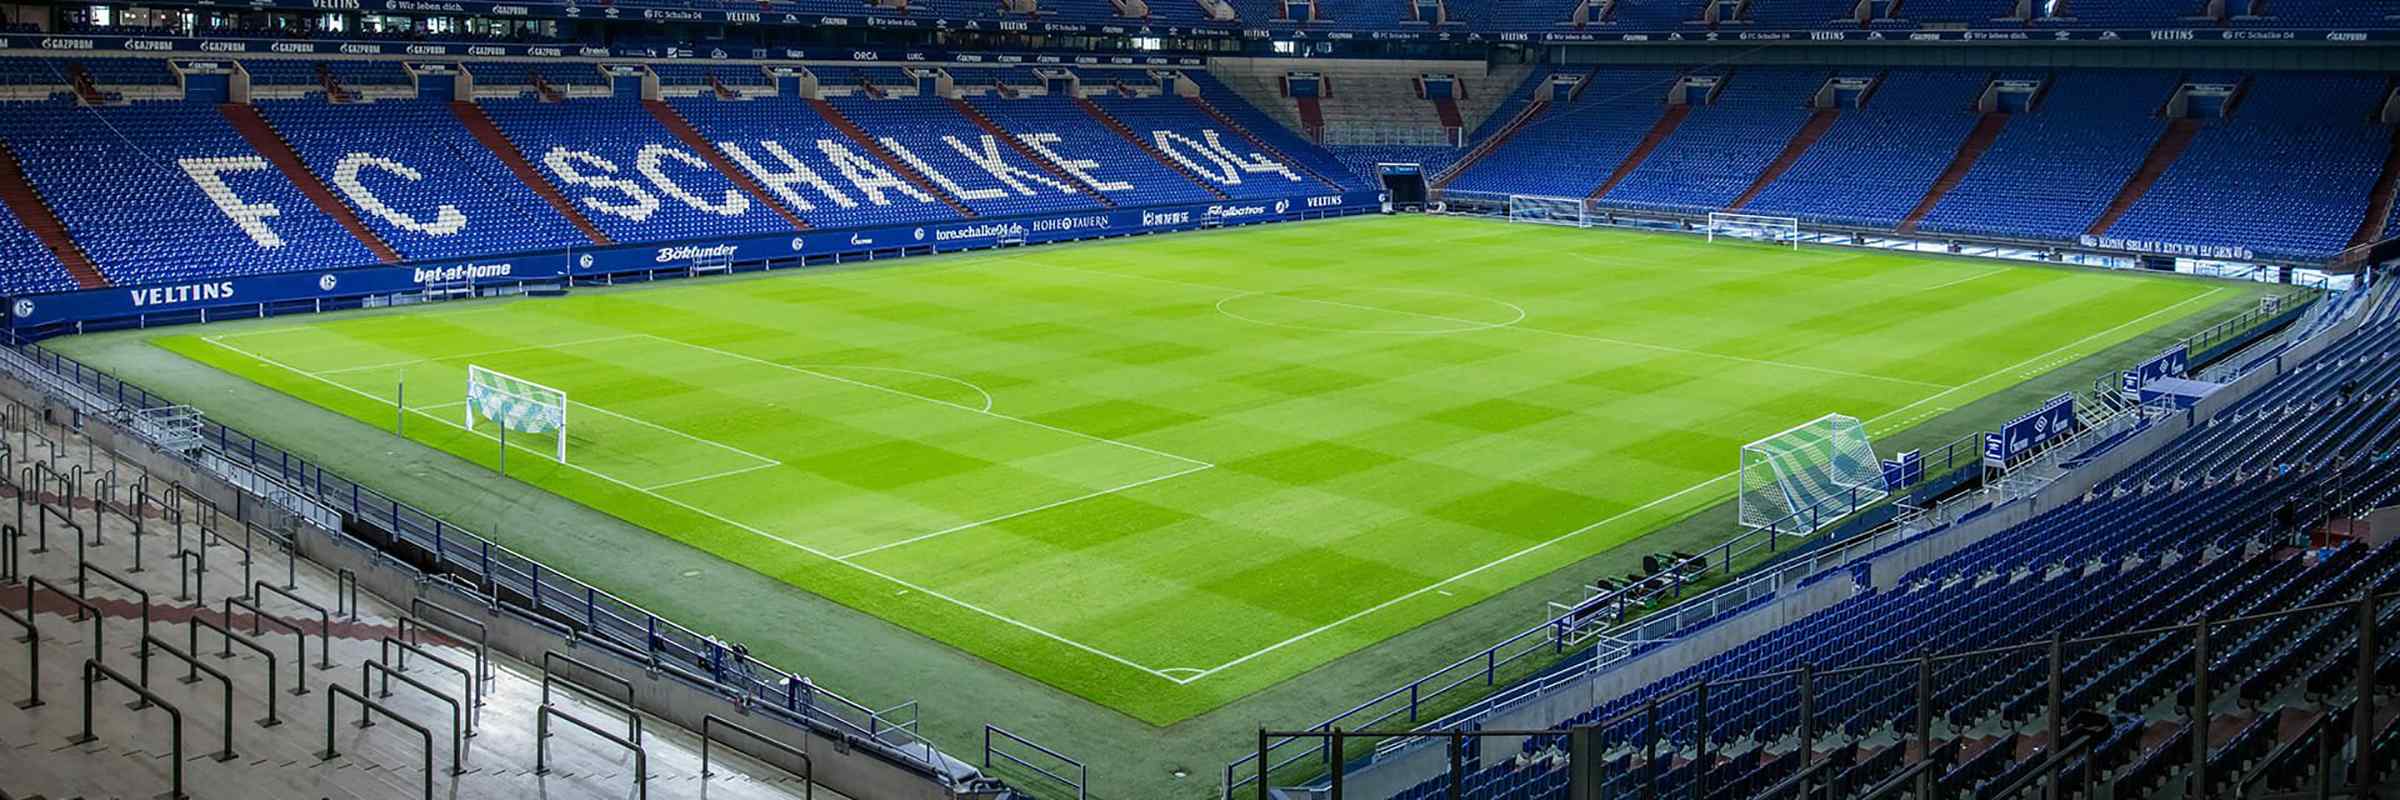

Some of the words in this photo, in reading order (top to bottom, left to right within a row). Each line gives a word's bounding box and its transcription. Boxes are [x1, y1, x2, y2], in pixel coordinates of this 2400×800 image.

[312, 0, 360, 9] VELTINS
[726, 12, 760, 22] VELTINS
[1000, 21, 1028, 30] VELTINS
[1500, 32, 1528, 40] VELTINS
[1810, 31, 1845, 40] VELTINS
[2150, 30, 2194, 40] VELTINS
[52, 39, 93, 49] GAZPROM
[135, 41, 173, 50] GAZPROM
[209, 42, 246, 51] GAZPROM
[279, 43, 314, 52] GAZPROM
[854, 51, 879, 60] ORCA
[178, 152, 467, 250] FC
[543, 132, 1135, 222] SCHALKE
[1152, 128, 1302, 186] 04
[1306, 195, 1342, 208] VELTINS
[1033, 218, 1062, 231] HOHE
[1071, 215, 1111, 230] TAUERN
[655, 243, 738, 263] Böklunder
[413, 263, 512, 283] bet-at-home
[130, 281, 235, 307] VELTINS
